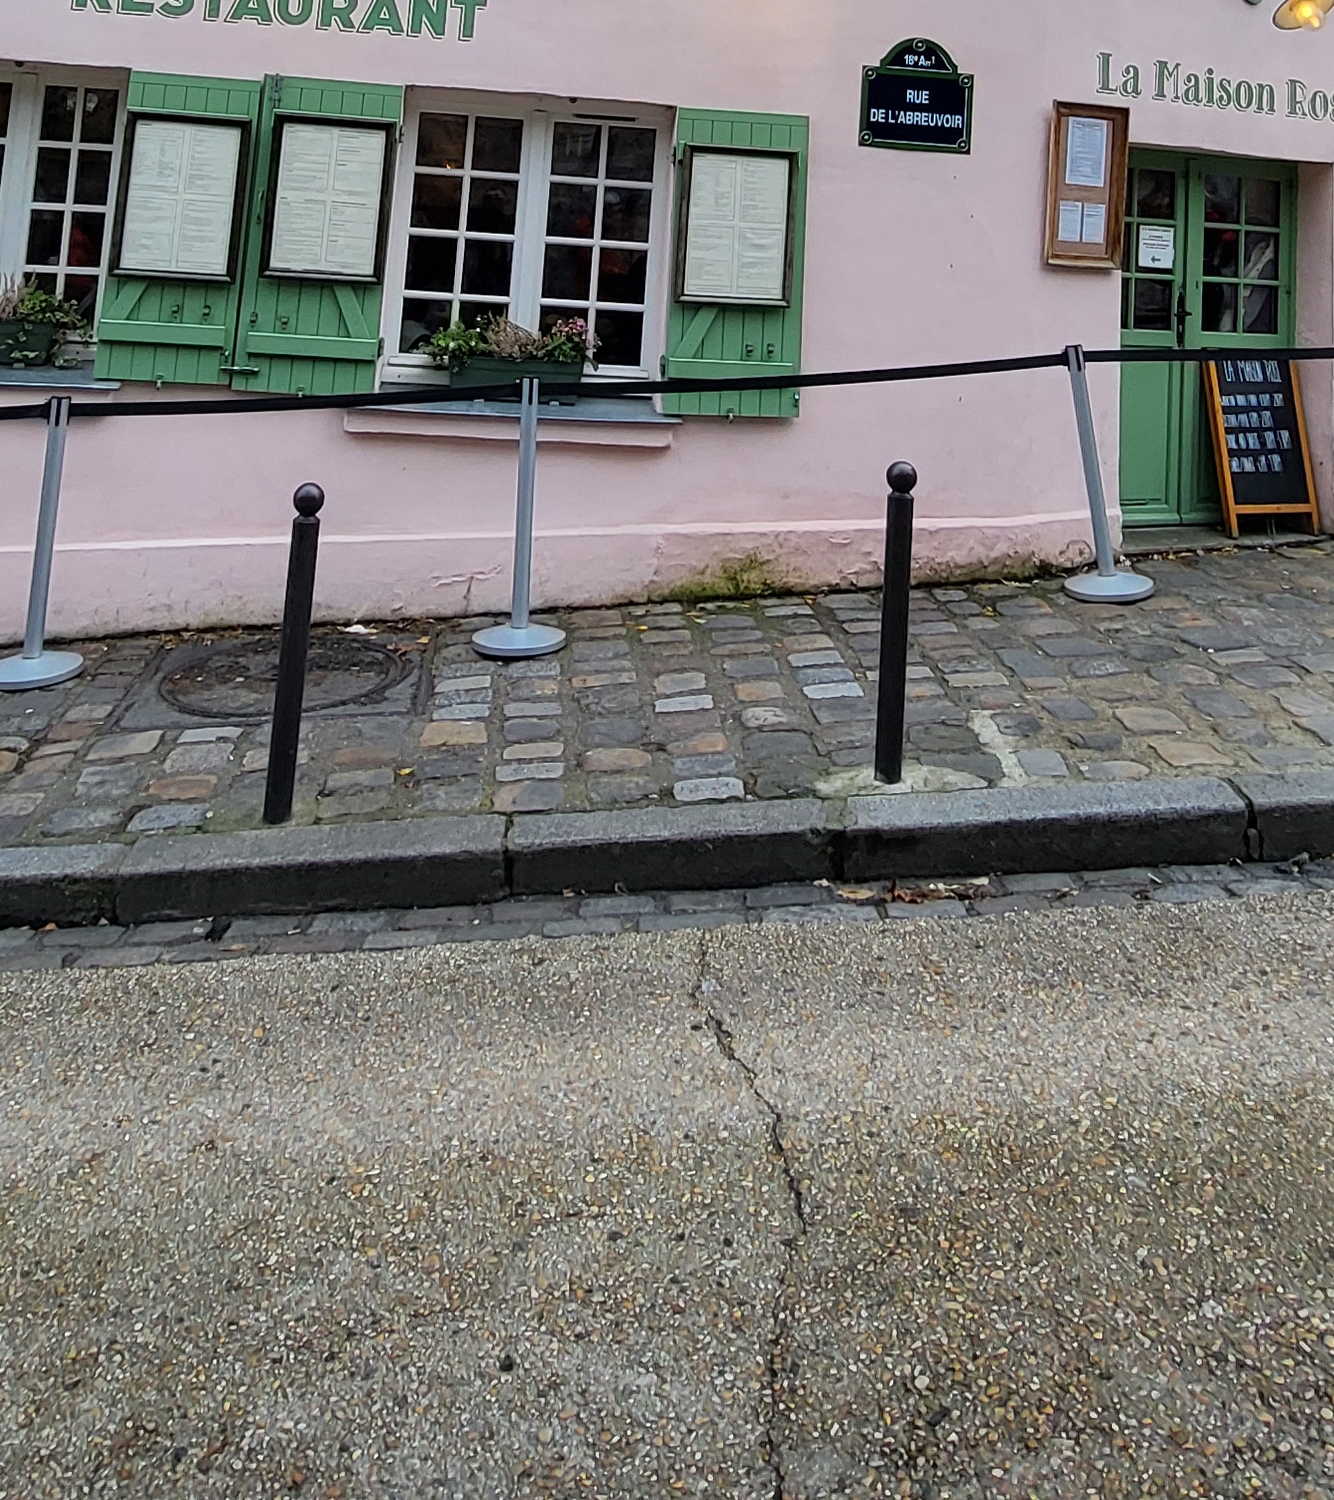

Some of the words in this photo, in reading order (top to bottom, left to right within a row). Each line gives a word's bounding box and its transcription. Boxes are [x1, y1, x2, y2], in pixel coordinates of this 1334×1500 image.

[1096, 52, 1142, 98] La
[1152, 59, 1276, 114] Maison
[906, 89, 930, 104] RUE
[870, 108, 886, 122] DE
[888, 109, 963, 128] L'ABREUVOIR
